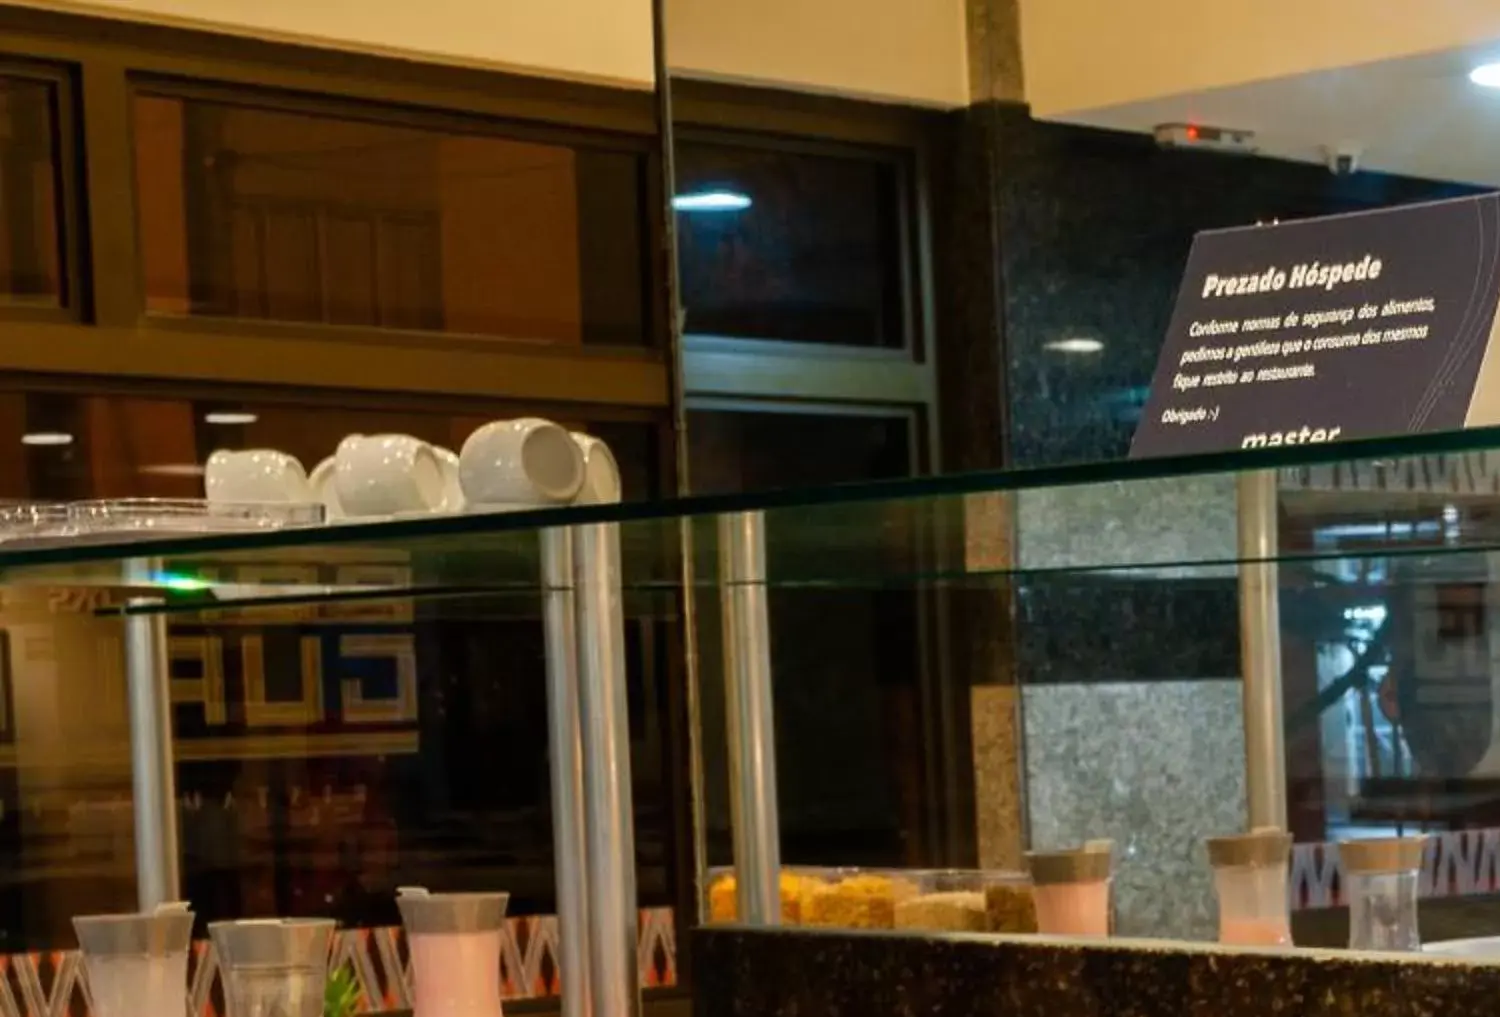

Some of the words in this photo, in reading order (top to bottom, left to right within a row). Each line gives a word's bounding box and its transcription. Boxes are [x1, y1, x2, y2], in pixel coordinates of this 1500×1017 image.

[1202, 265, 1286, 299] Prezado
[1289, 253, 1382, 291] Hóspede
[1283, 312, 1299, 328] de
[1357, 303, 1378, 319] dos
[1226, 346, 1234, 359] a
[1281, 339, 1302, 357] que
[1303, 339, 1312, 351] o
[1361, 329, 1381, 345] dos
[1173, 373, 1201, 392] fique
[1240, 371, 1255, 383] ao
[1161, 406, 1207, 425] Obrigado
[1241, 424, 1341, 449] master
